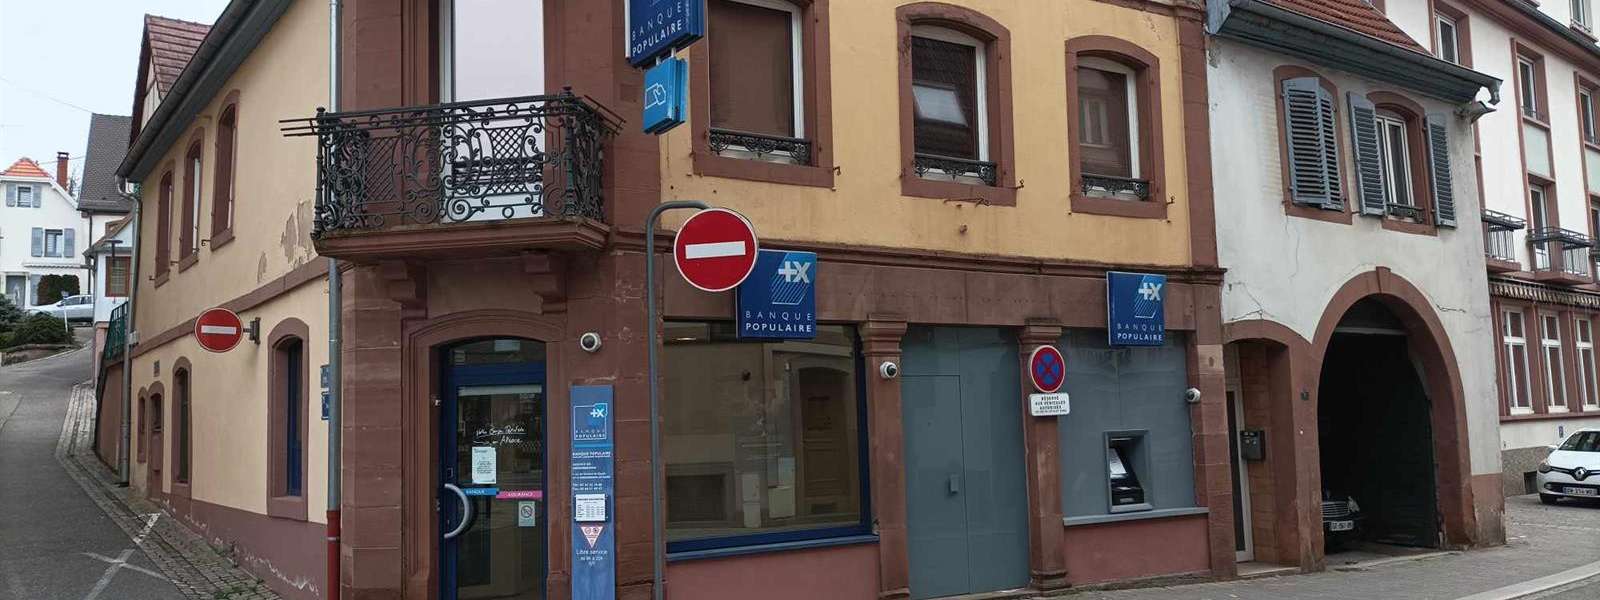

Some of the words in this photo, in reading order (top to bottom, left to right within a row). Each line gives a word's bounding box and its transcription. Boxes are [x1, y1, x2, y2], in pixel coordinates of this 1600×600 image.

[632, 1, 682, 41] BANQUE
[632, 19, 682, 57] POPULAIRE
[745, 310, 813, 321] BANQUE
[745, 322, 813, 333] POPULAIRE
[1117, 323, 1163, 332] BANQUE
[1117, 332, 1163, 342] POPULAIRE
